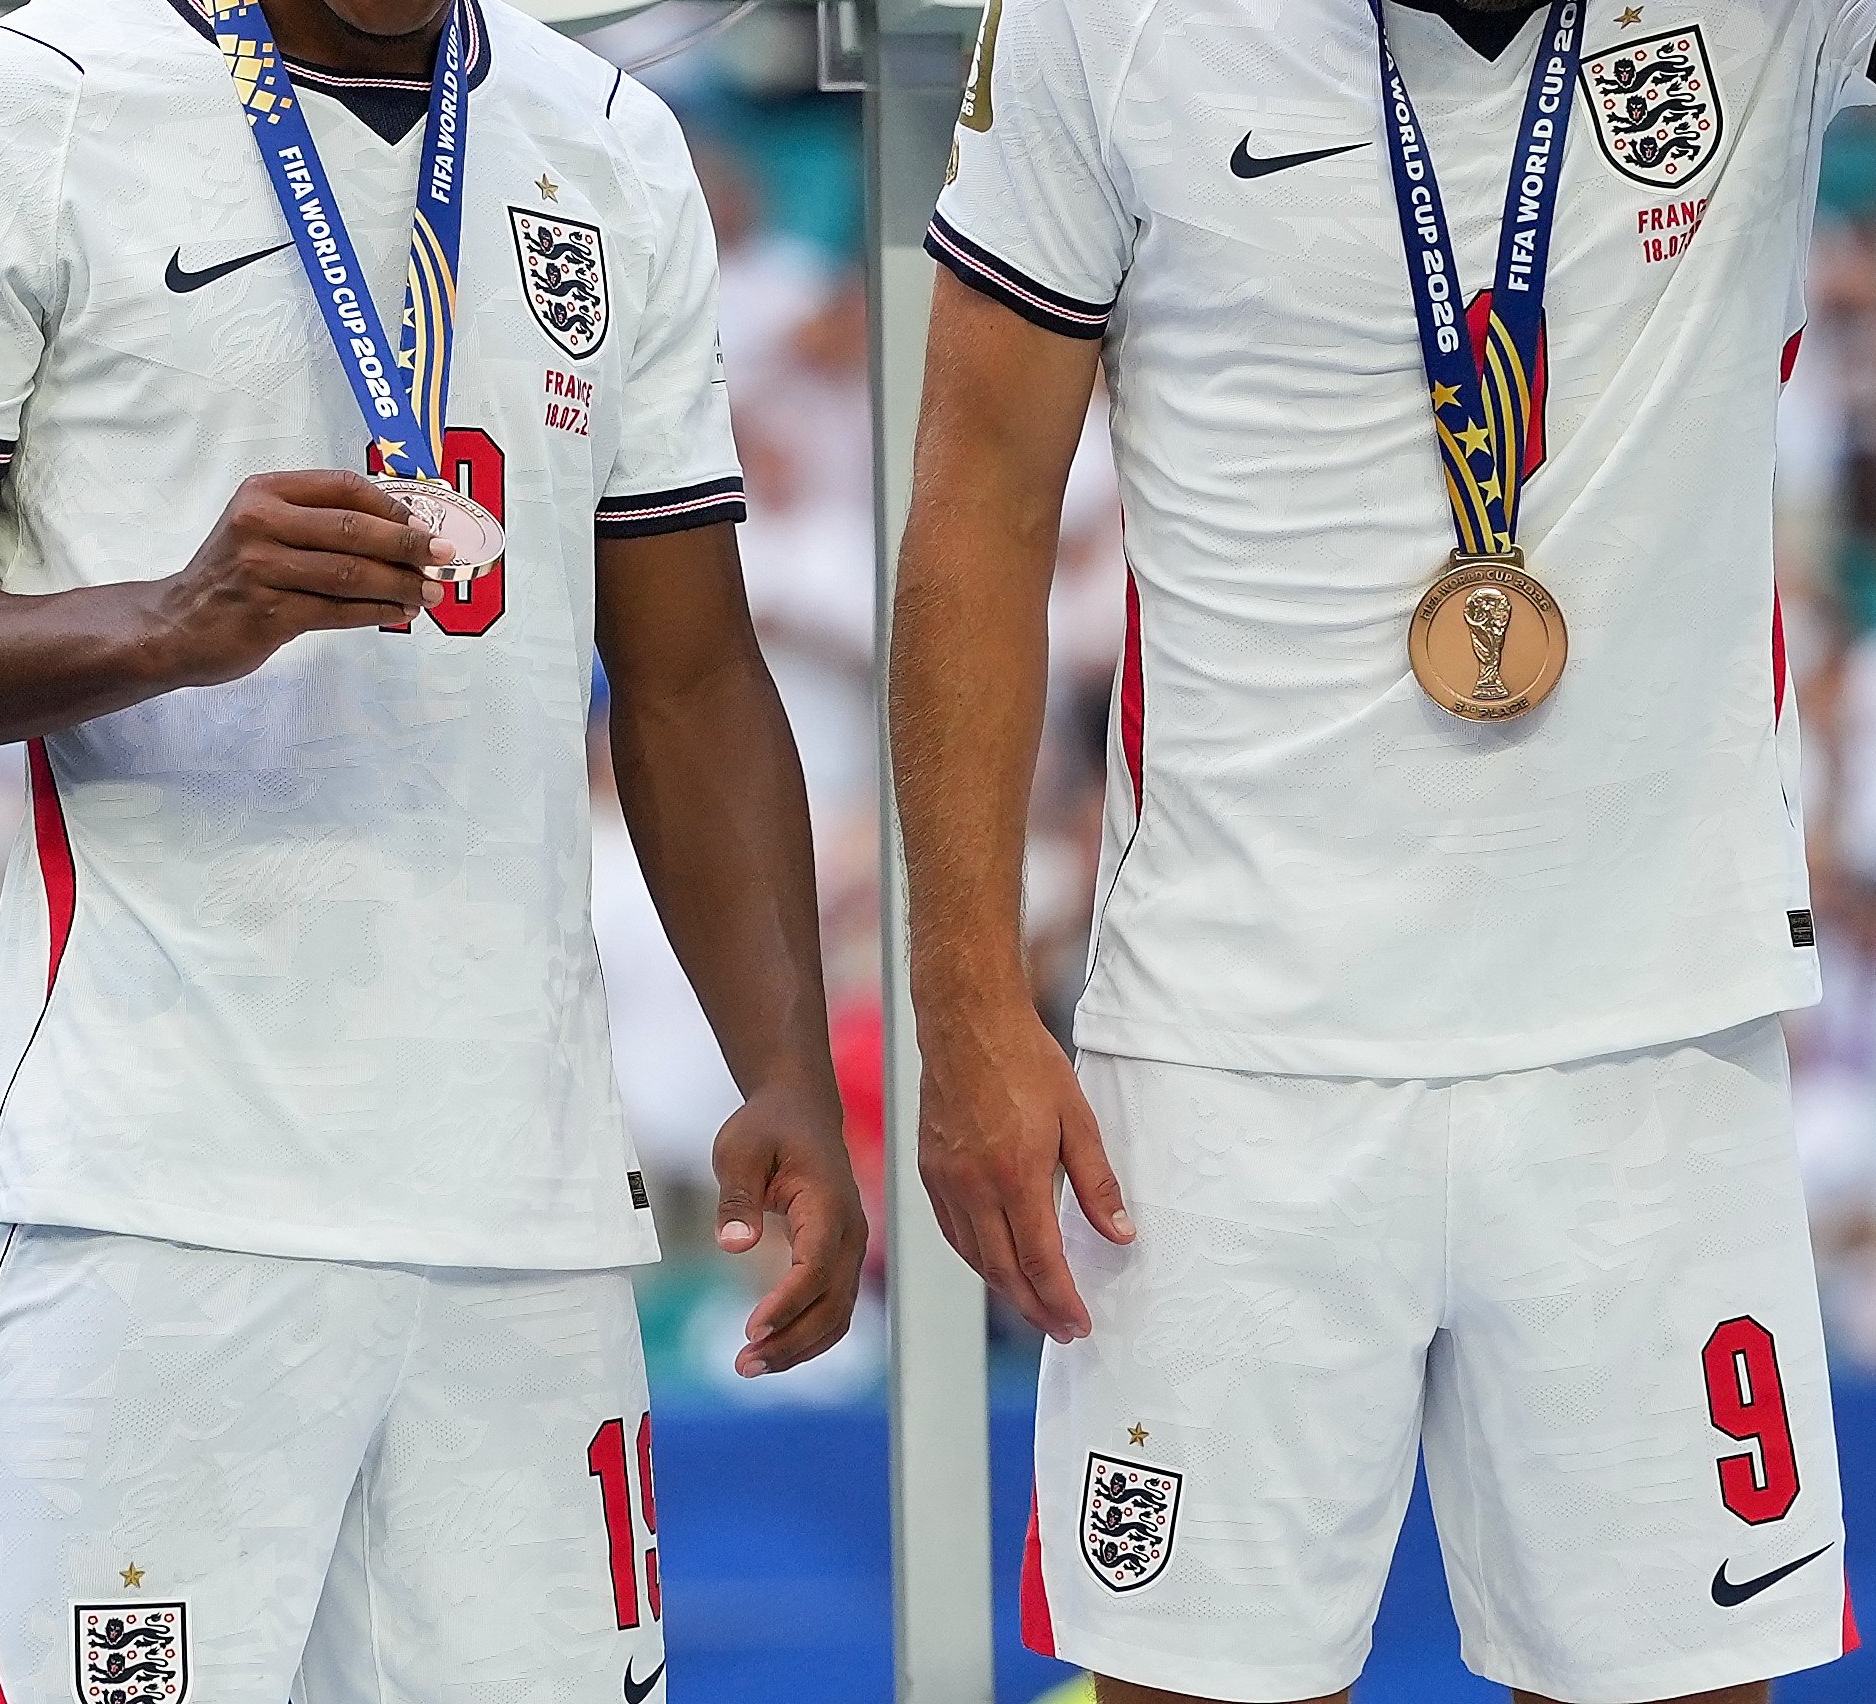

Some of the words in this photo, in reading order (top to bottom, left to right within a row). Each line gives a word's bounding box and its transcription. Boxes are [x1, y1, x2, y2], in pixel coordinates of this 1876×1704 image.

[446, 24, 459, 72] CUP
[437, 70, 459, 153] WORLD
[1541, 56, 1567, 115] CUP
[1390, 76, 1425, 182] WORLD
[430, 155, 454, 204] FIFA
[1516, 118, 1554, 225] WORLD
[1410, 185, 1439, 245] CUP
[278, 145, 315, 201] FIFA
[299, 197, 348, 286] WORLD
[332, 287, 367, 335] CUP
[350, 336, 400, 420] 2026
[1508, 228, 1536, 292] FIFA
[1422, 247, 1459, 354] 2026
[1437, 570, 1484, 602] WORLD
[1486, 569, 1514, 583] CUP
[1515, 577, 1552, 613] 2026
[1477, 698, 1529, 719] PLACE
[1702, 1315, 1801, 1526] 9
